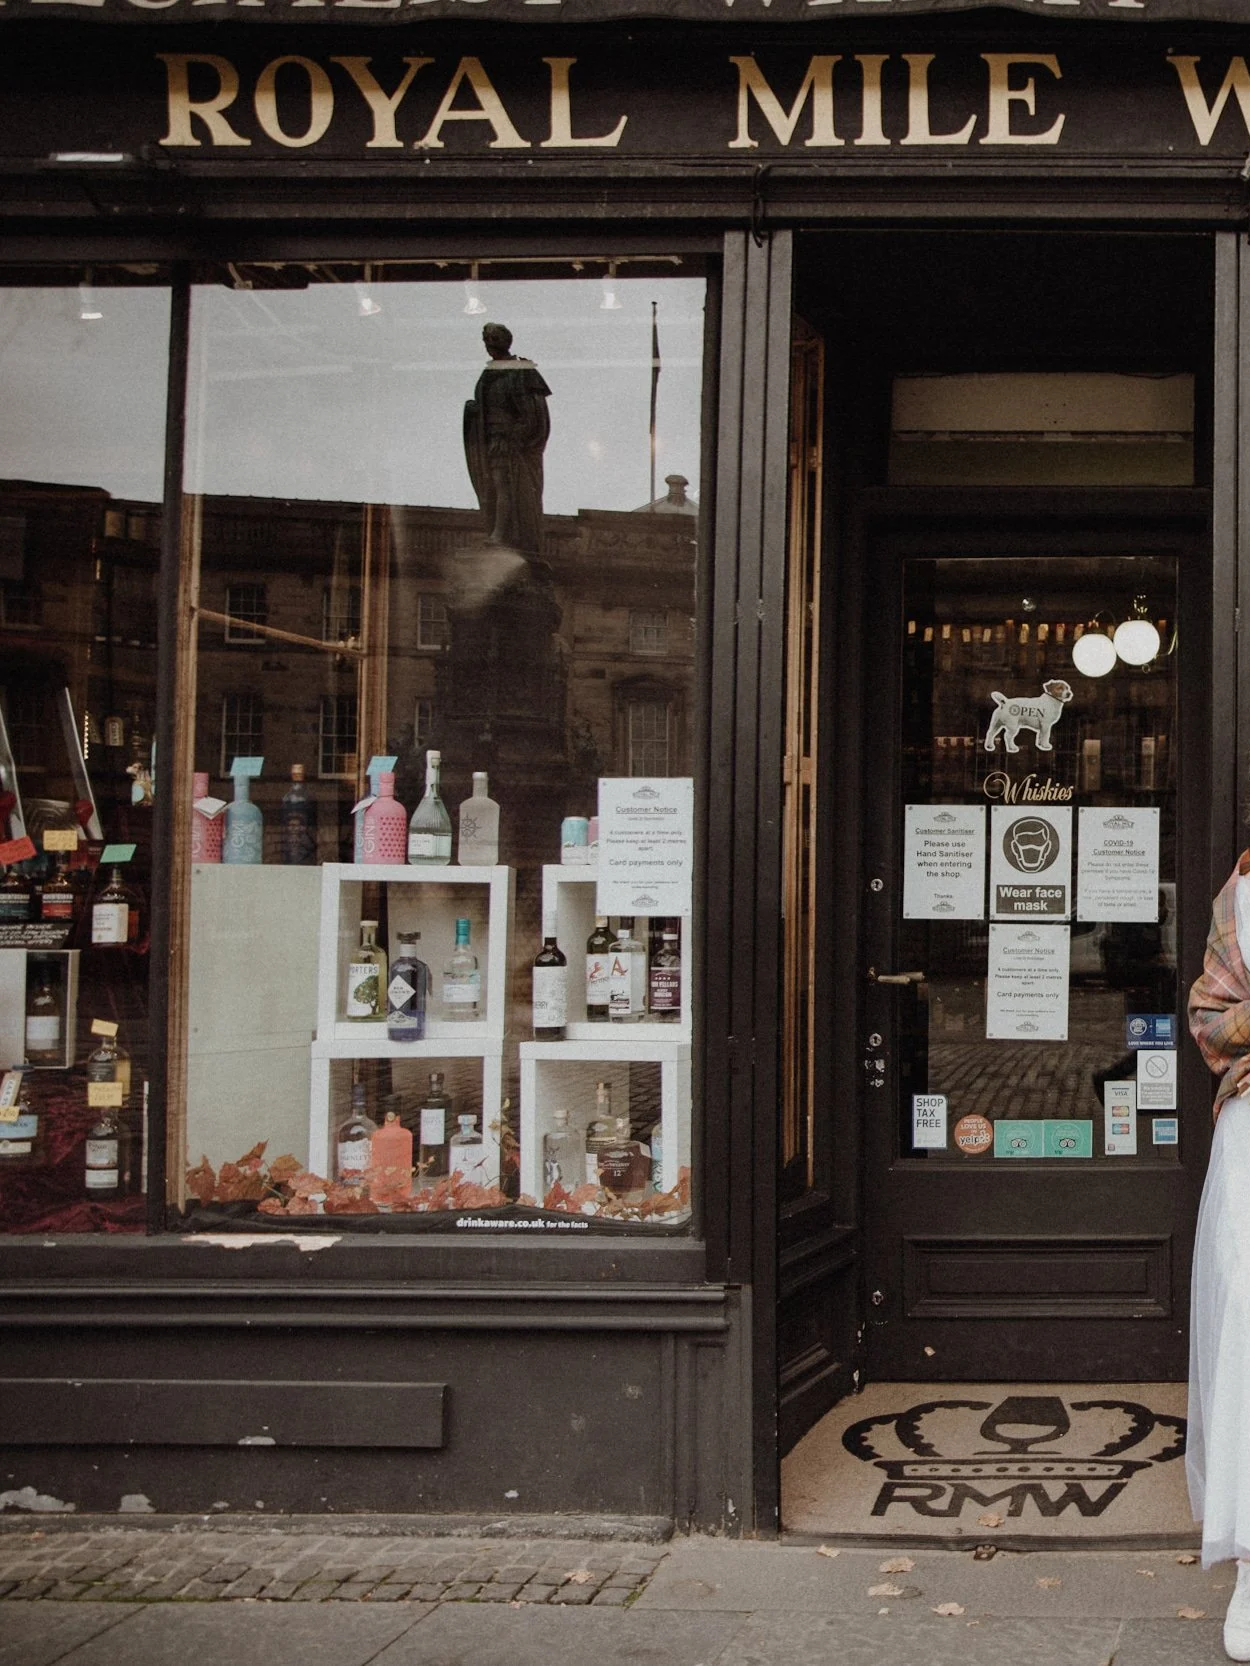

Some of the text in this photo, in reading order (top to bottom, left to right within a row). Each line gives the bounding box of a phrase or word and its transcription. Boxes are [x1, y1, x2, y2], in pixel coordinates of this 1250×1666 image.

[155, 53, 628, 150] ROYAL
[728, 53, 1066, 149] MILE
[1009, 704, 1045, 718] OPEN
[983, 771, 1074, 804] Whiskies
[628, 859, 664, 867] payments
[666, 859, 683, 867] only
[999, 886, 1062, 899] Wear face
[1013, 900, 1048, 911] mask
[1046, 991, 1059, 999] only
[916, 1098, 944, 1107] SHOP
[916, 1109, 936, 1118] TAX
[916, 1119, 941, 1128] FREE
[959, 1134, 980, 1146] yelp
[456, 1217, 589, 1229] drinkaware.co.uk for the facts
[871, 1481, 1127, 1518] RMW
